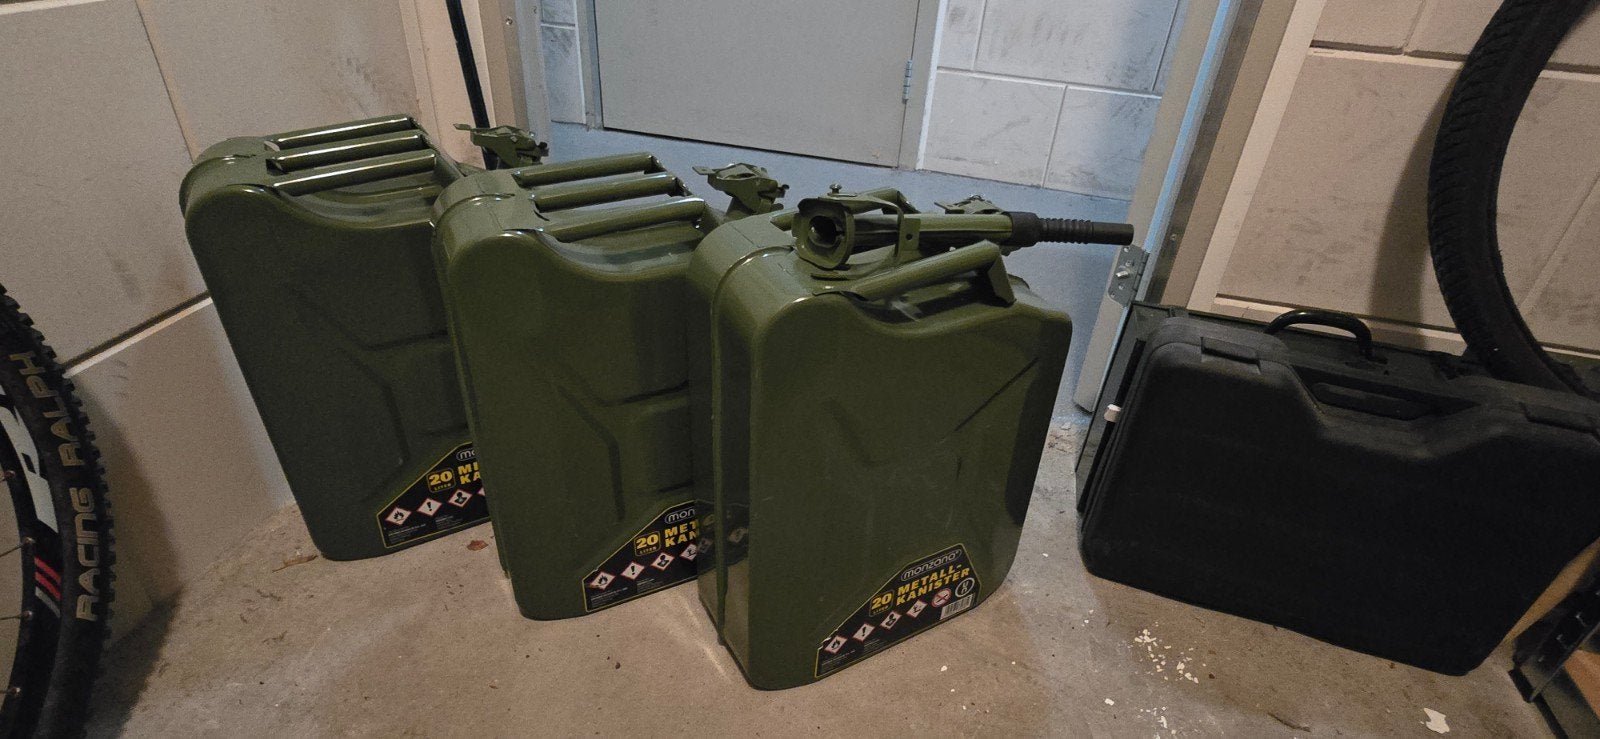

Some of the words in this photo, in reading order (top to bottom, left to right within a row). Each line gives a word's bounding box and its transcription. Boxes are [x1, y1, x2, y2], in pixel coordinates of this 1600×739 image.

[10, 350, 85, 467] RALPH
[429, 471, 452, 486] 20
[68, 486, 101, 622] RACING
[636, 535, 659, 550] 20
[896, 567, 970, 606] KANISTER
[897, 563, 962, 597] METALL-
[871, 592, 893, 609] 20
